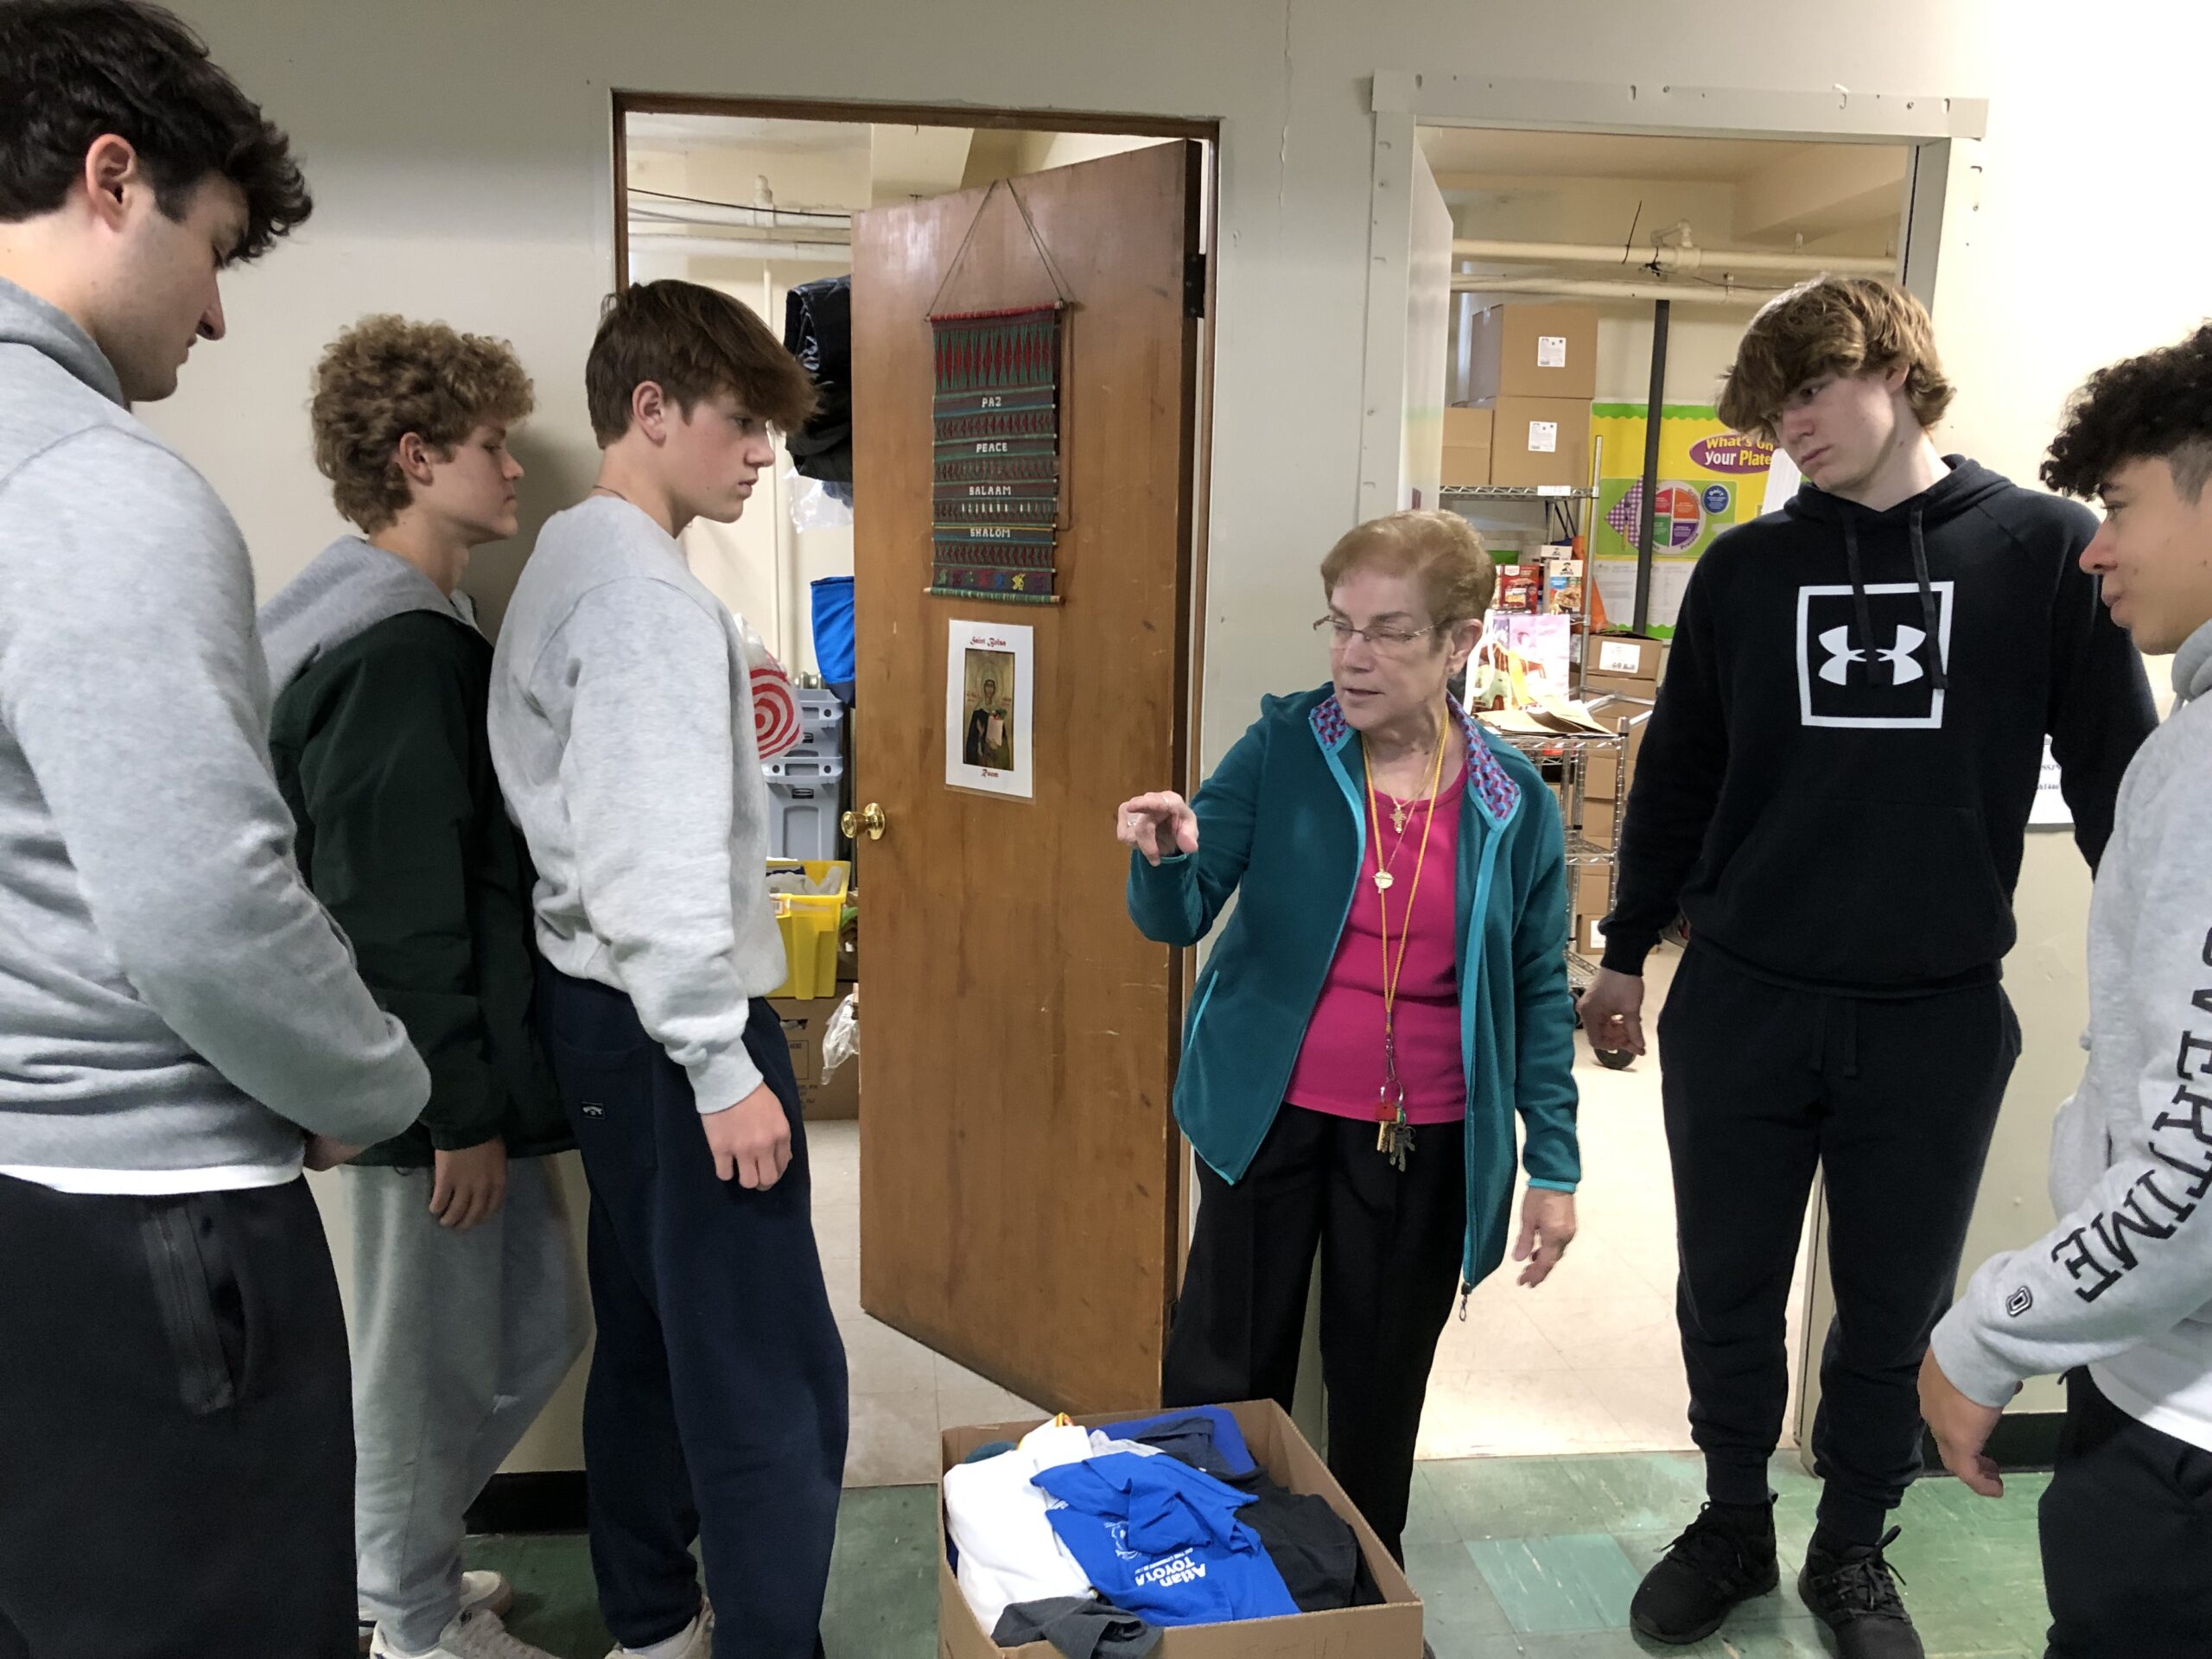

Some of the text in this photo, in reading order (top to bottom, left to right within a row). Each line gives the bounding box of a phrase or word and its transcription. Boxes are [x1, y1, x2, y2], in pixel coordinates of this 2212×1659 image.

[982, 396, 1001, 408] PAZ
[976, 442, 1008, 453] PEACE
[1706, 435, 1752, 450] What's
[1704, 451, 1737, 466] your
[969, 486, 1011, 496] SALAAM
[969, 528, 1010, 537] SHALOM
[1135, 1556, 1195, 1586] TOYOTA
